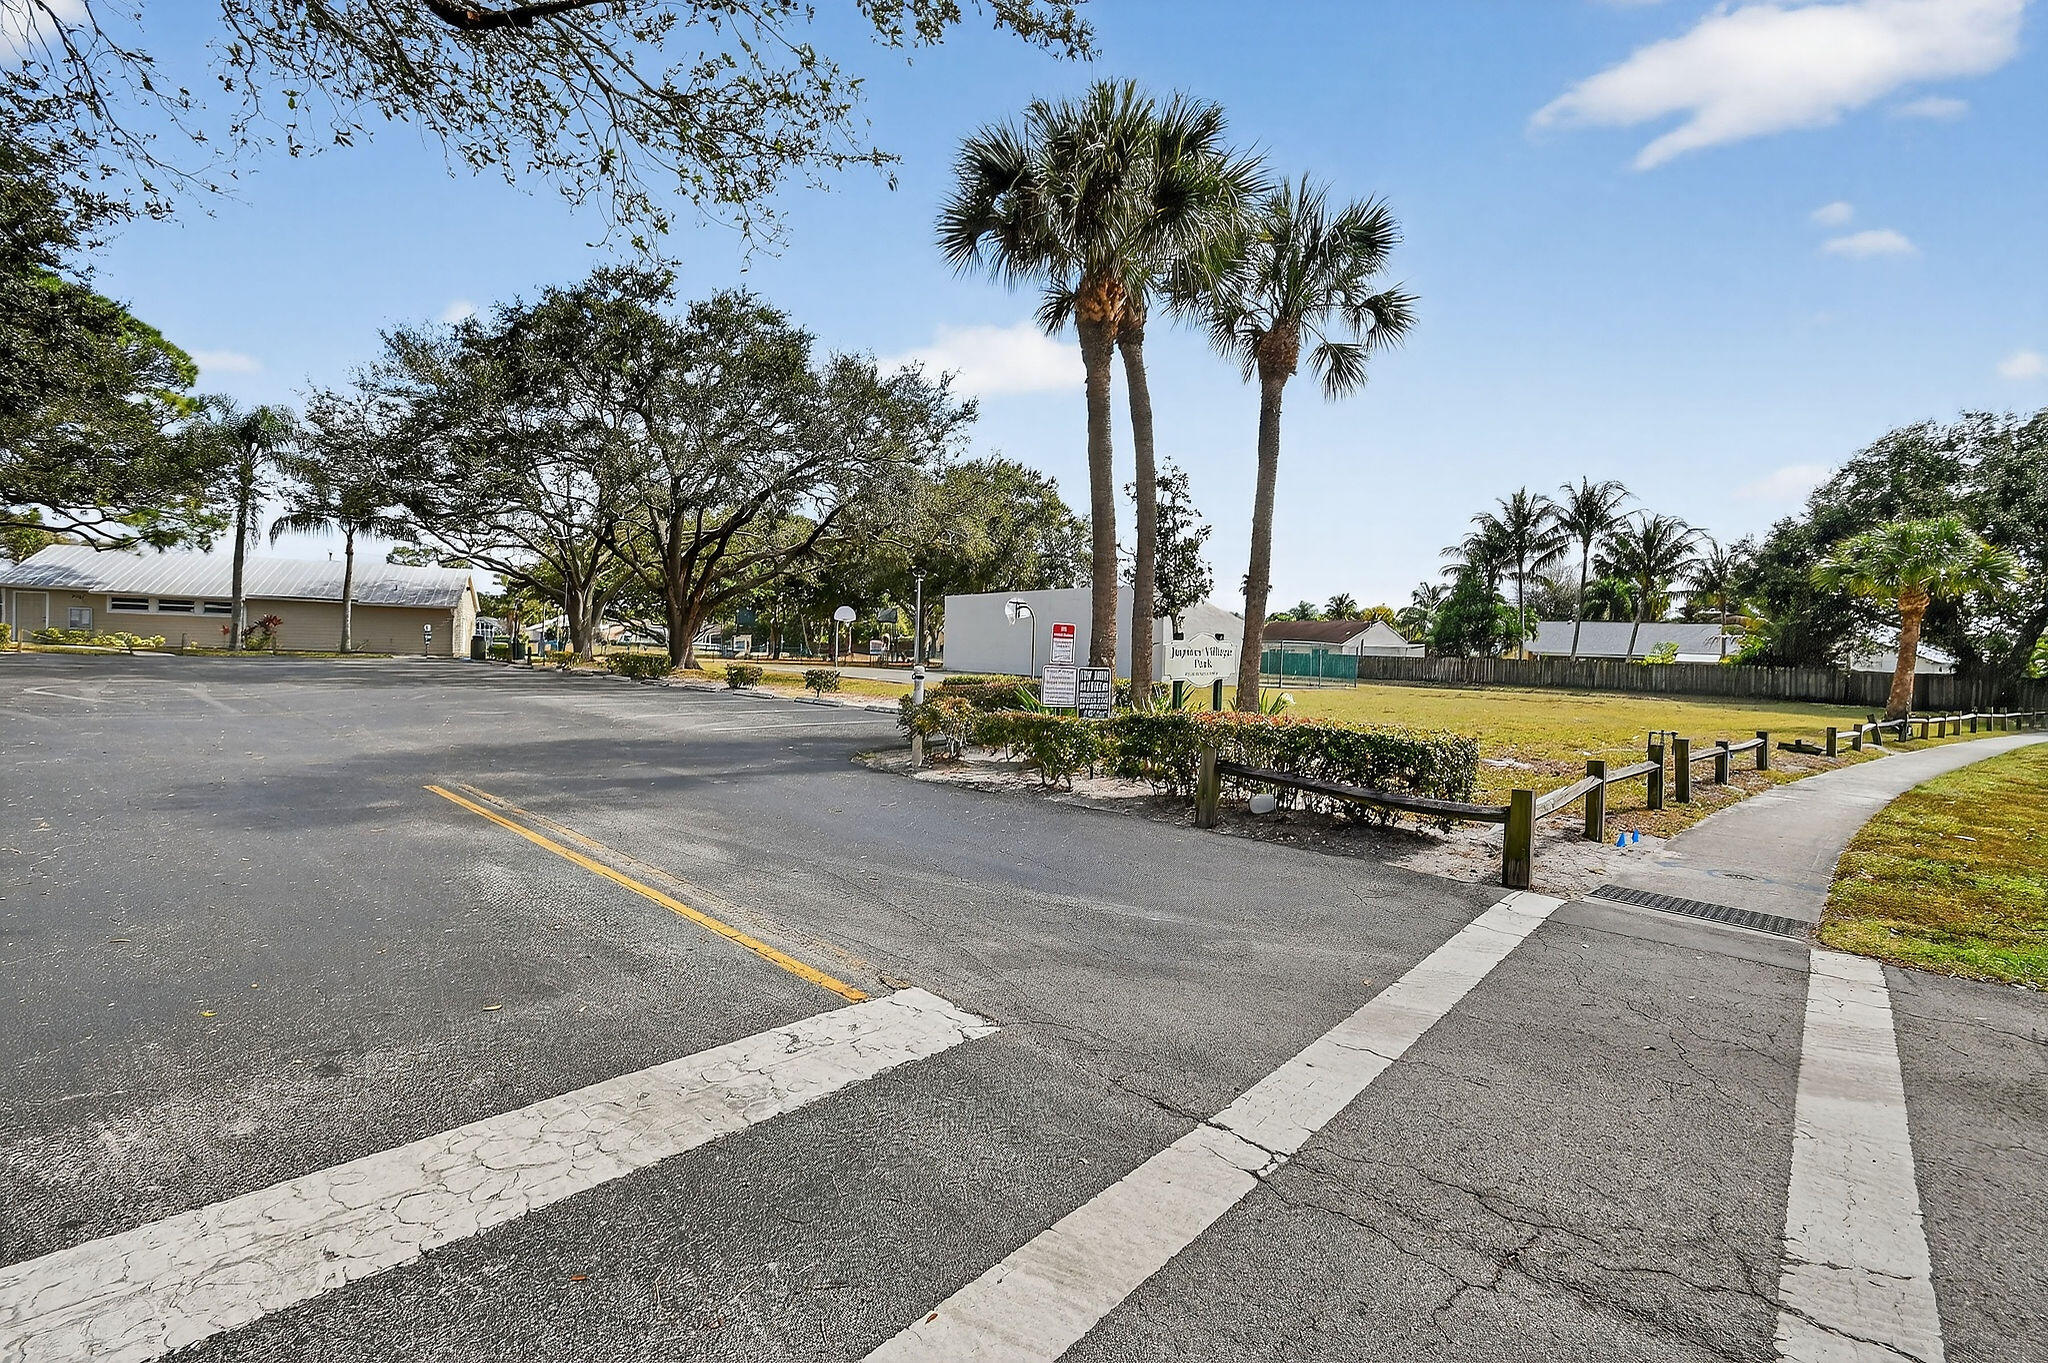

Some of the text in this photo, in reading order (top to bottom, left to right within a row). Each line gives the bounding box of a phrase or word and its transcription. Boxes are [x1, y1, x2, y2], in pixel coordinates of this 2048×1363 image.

[1172, 647, 1232, 659] Jupiter Village
[1194, 659, 1212, 668] Park
